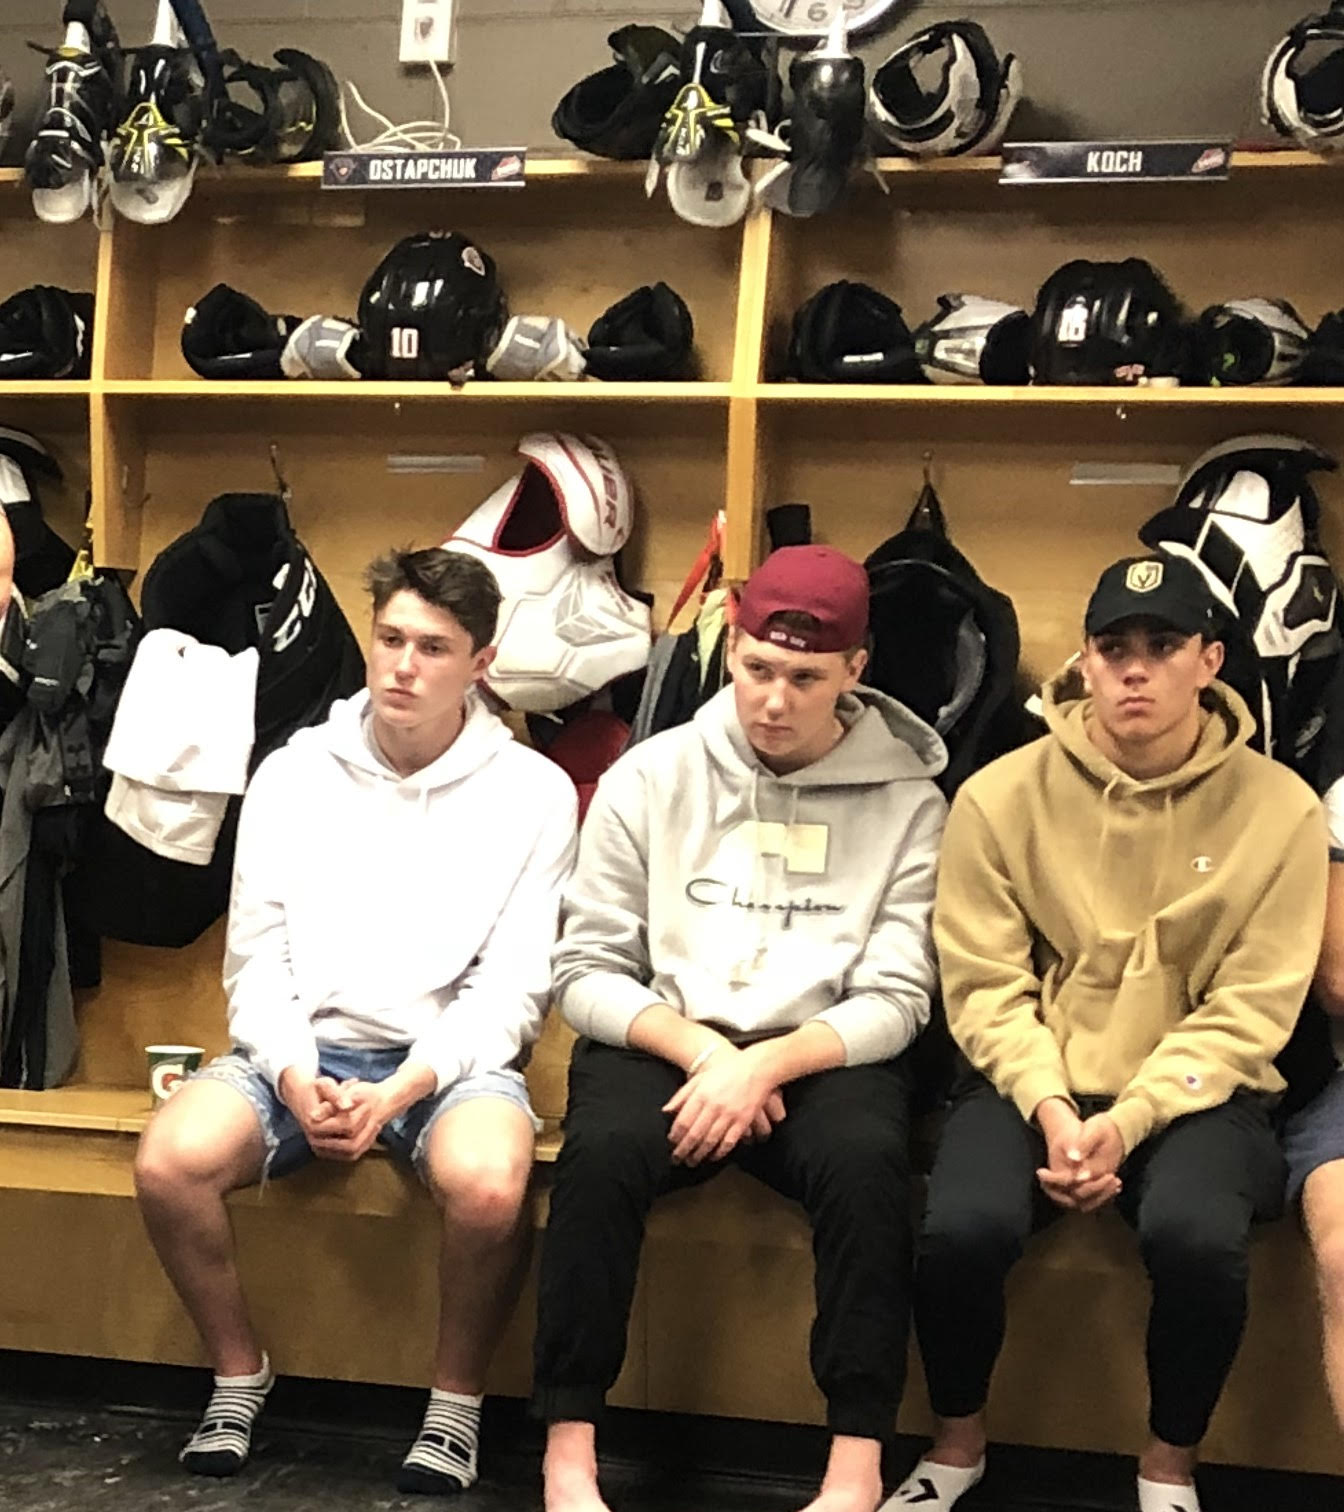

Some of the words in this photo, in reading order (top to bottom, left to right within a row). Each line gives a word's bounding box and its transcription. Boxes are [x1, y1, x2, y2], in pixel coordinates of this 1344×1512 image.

[368, 157, 478, 181] OSTAPCHUK
[1086, 150, 1143, 173] KOCH
[391, 327, 419, 359] 10
